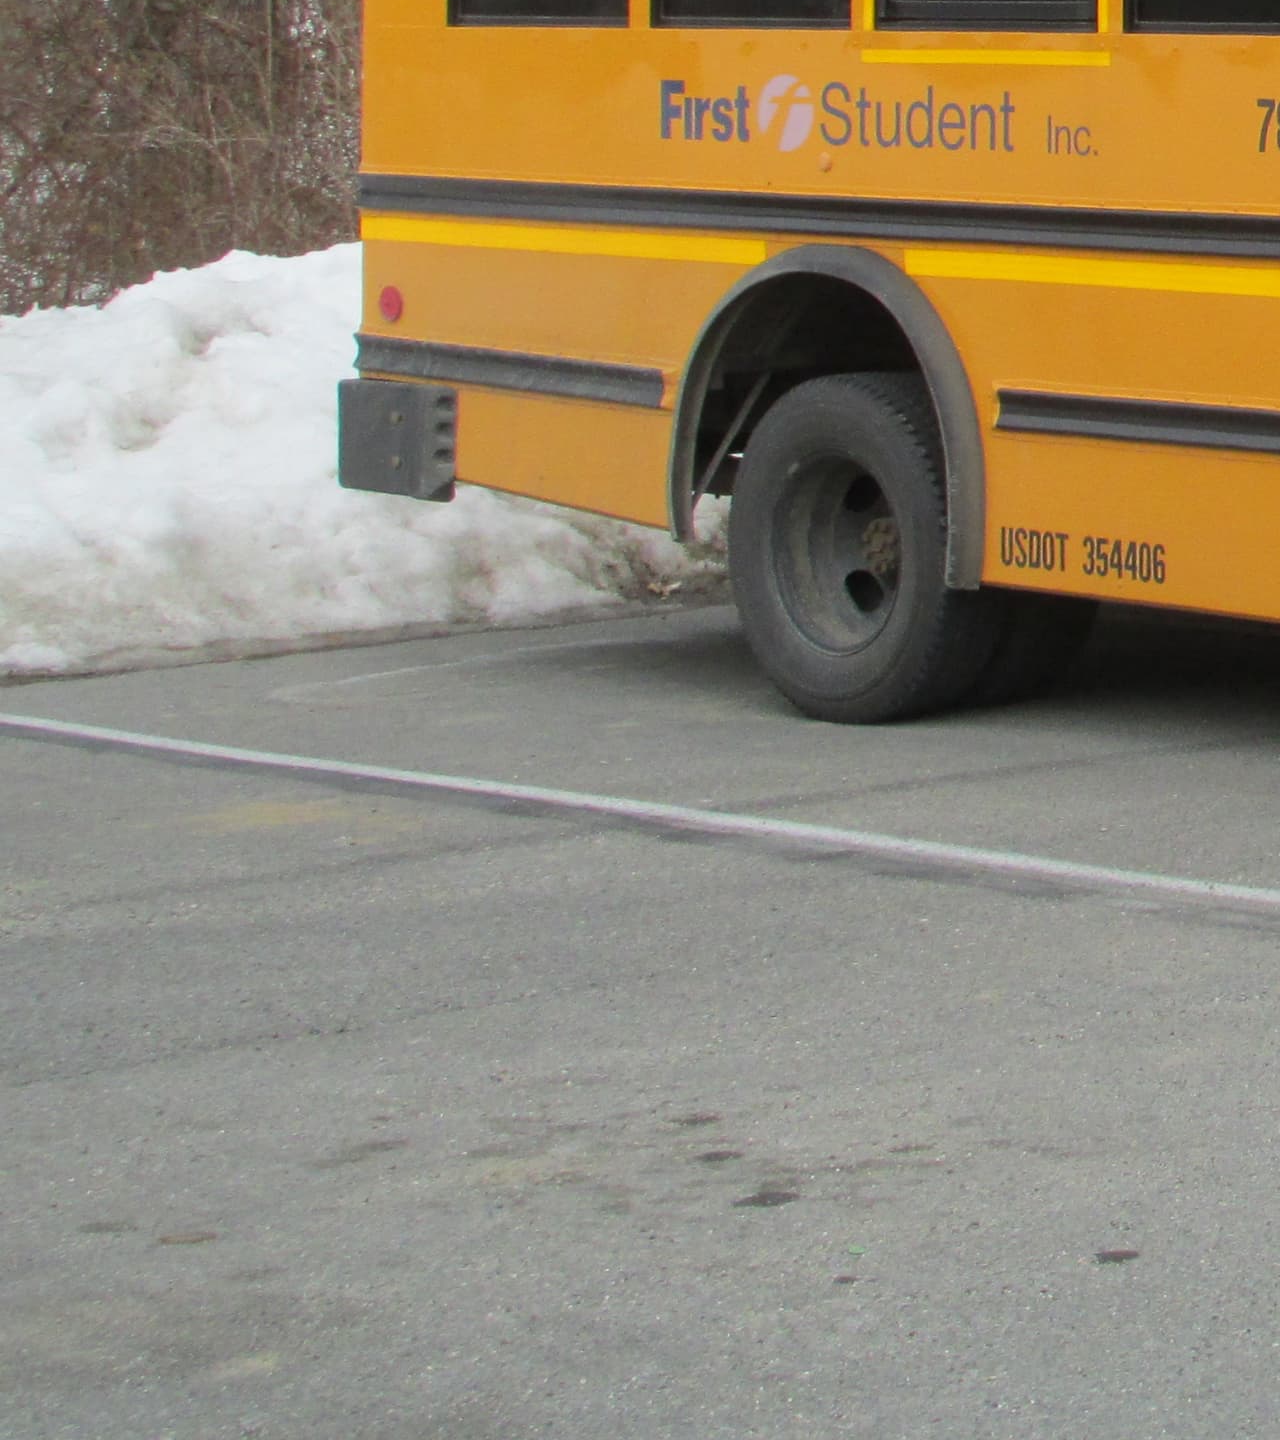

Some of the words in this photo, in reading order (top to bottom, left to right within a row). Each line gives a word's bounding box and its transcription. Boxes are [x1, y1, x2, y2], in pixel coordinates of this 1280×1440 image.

[660, 79, 750, 143] First
[820, 81, 1015, 152] Student
[1047, 115, 1098, 156] Inc.
[1001, 526, 1069, 572] USDOT
[1082, 536, 1166, 585] 354406
